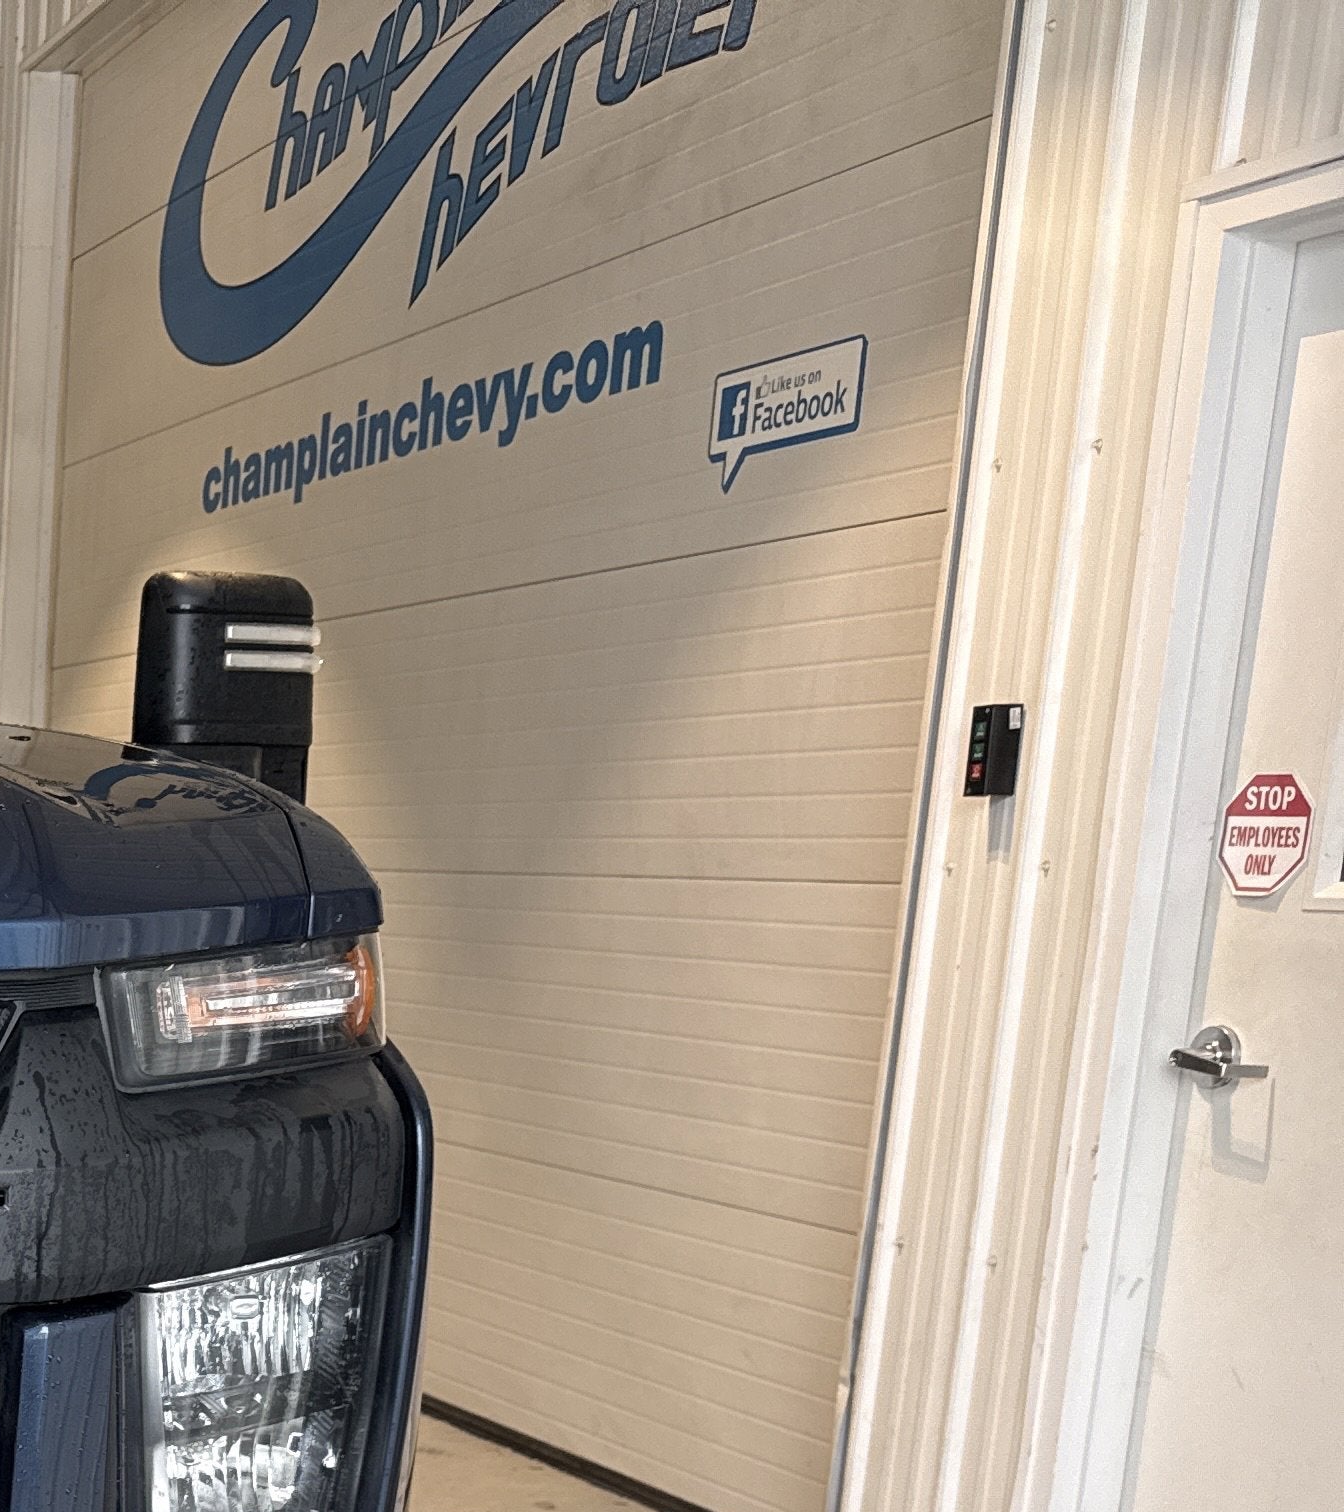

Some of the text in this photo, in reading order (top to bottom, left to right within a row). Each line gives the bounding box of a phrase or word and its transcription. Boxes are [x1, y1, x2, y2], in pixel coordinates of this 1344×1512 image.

[771, 370, 822, 394] Like us on
[201, 319, 664, 514] champlainchevy.com
[752, 379, 848, 434] Facebook
[1244, 785, 1297, 811] STOP
[1228, 825, 1301, 850] EMPLOYEES
[1243, 854, 1278, 877] ONLY
